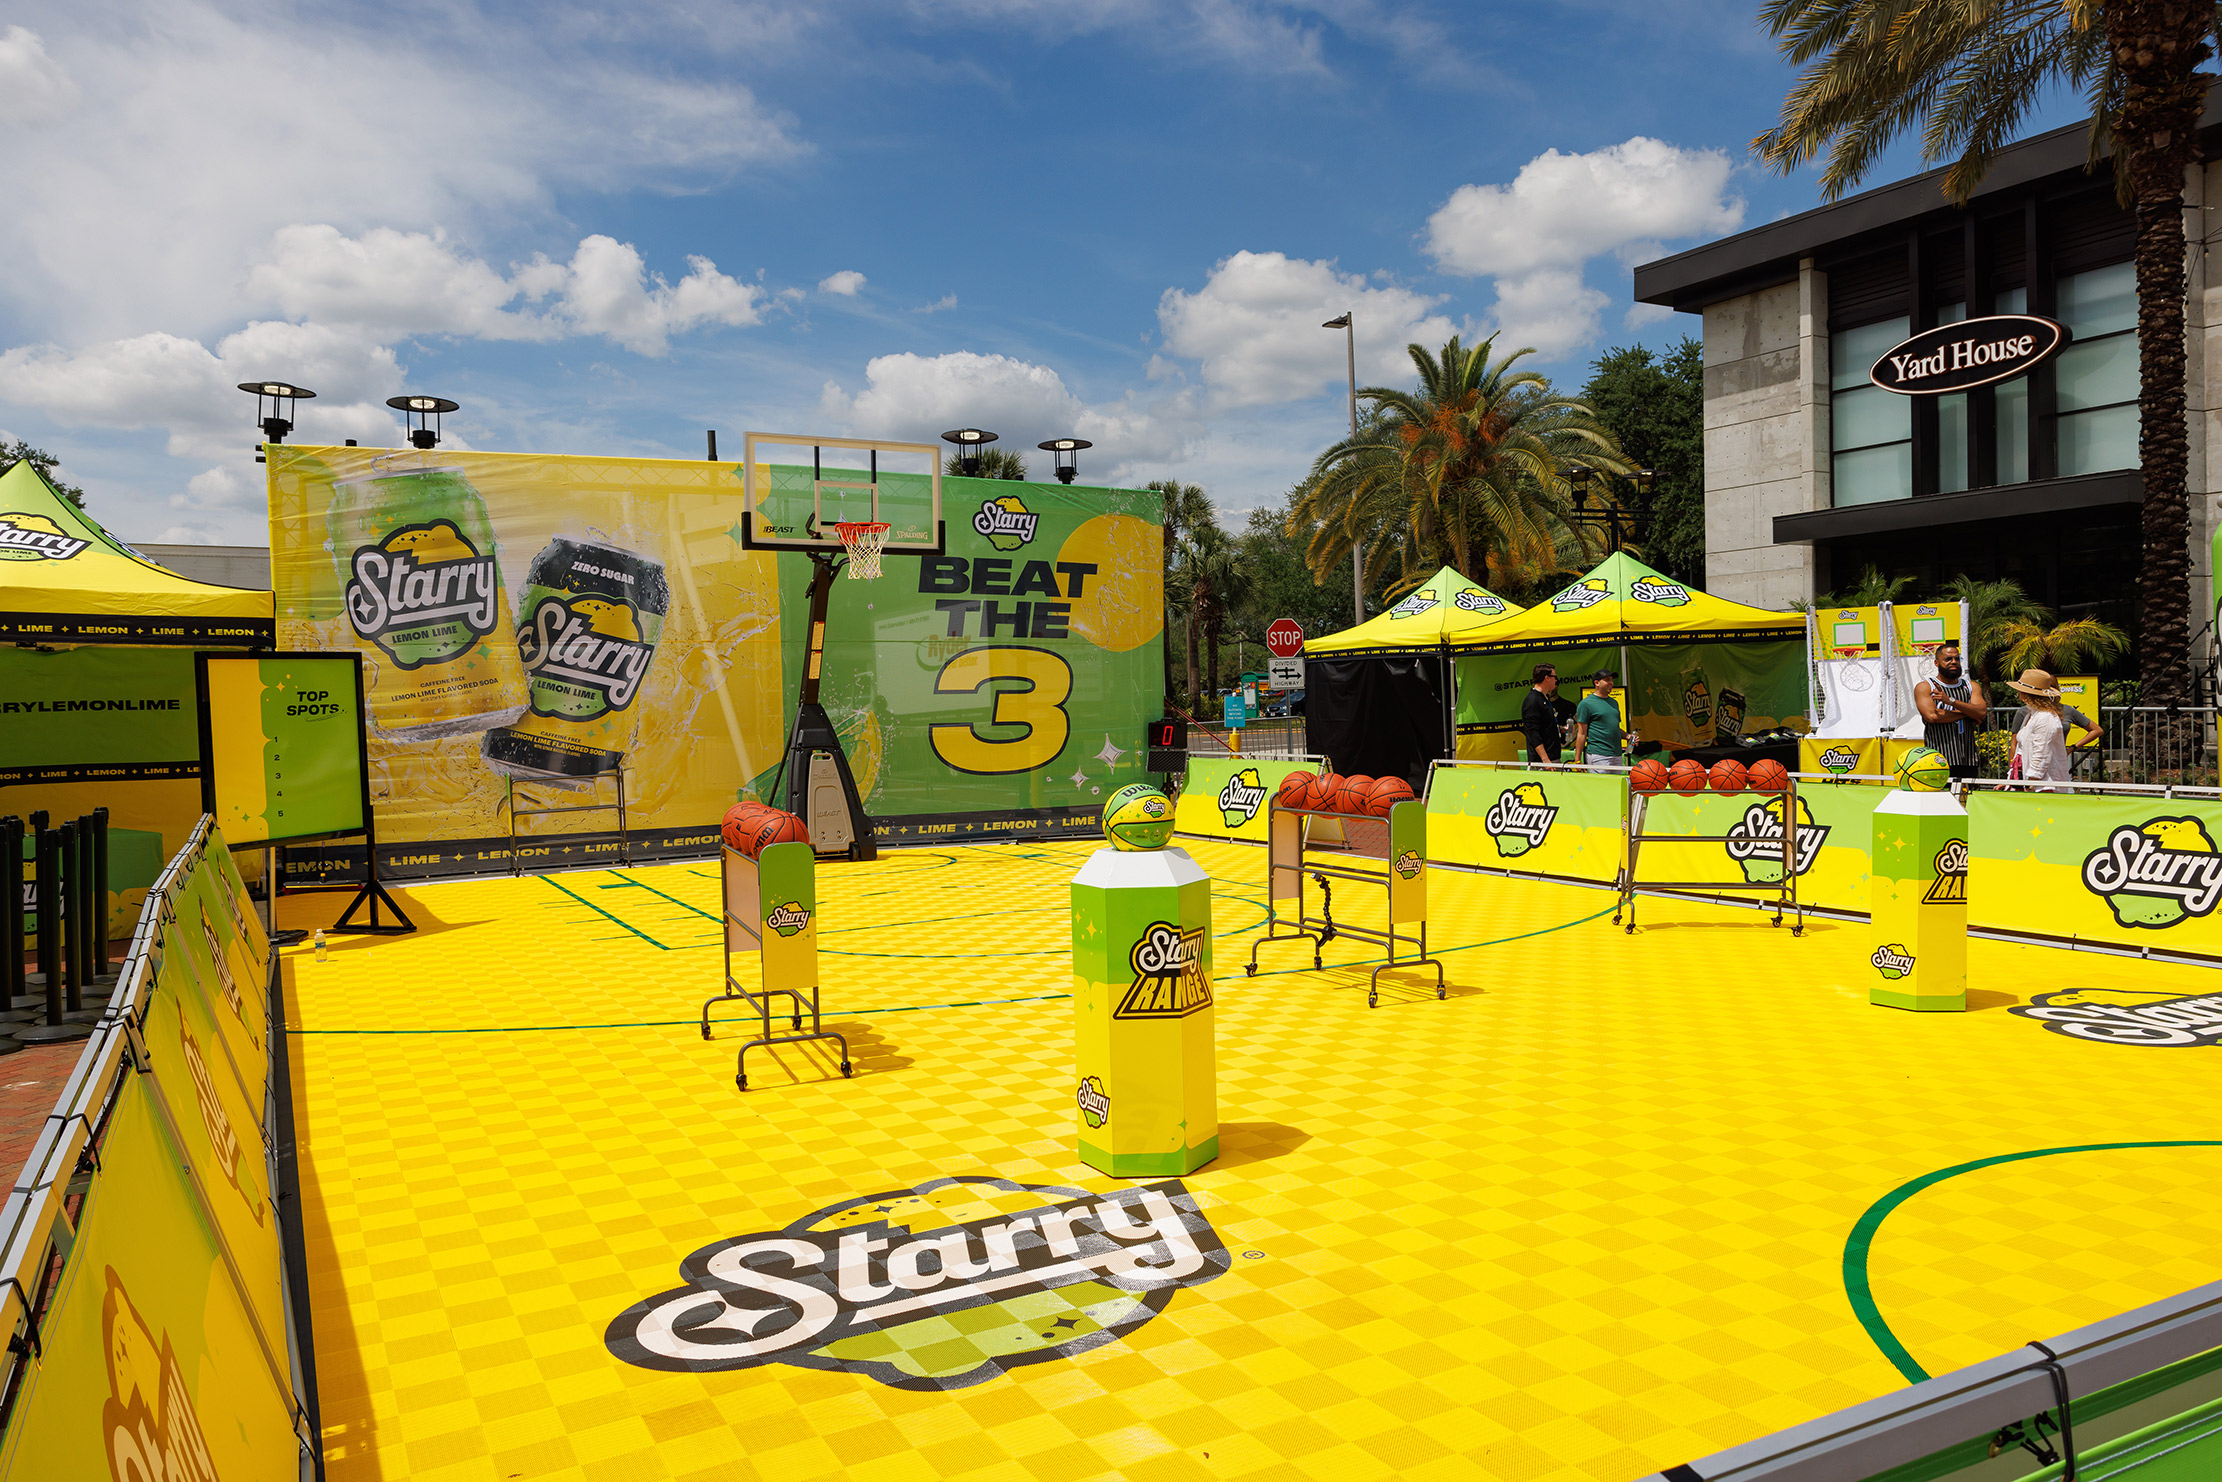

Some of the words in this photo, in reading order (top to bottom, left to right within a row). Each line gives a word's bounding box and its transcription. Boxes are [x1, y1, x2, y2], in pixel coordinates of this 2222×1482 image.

[1890, 346, 1946, 382] Yard
[1951, 334, 2036, 370] House
[764, 526, 795, 534] BEAST
[974, 502, 1038, 542] Starry
[896, 530, 928, 540] SPALDING
[570, 561, 600, 576] ZERO
[600, 567, 635, 585] SUGAR
[918, 556, 1098, 598] BEAT
[348, 551, 494, 634] Starry
[1456, 592, 1505, 610] Starry
[1552, 584, 1612, 608] Starry
[1632, 583, 1690, 602] Starry
[935, 600, 1071, 638] THE
[78, 626, 128, 634] LEMON
[152, 627, 184, 635] LIME
[208, 628, 254, 636] LEMON
[392, 630, 430, 644] LEMON
[432, 625, 458, 638] LIME
[1270, 631, 1301, 646] STOP
[517, 603, 652, 706] Starry
[391, 693, 416, 702] LEMON
[417, 689, 436, 698] LIME
[437, 681, 479, 694] FLAVORED
[479, 678, 499, 686] SODA
[420, 678, 450, 688] CAFFEINE
[538, 680, 571, 696] LEMON
[572, 688, 596, 700] LIME
[297, 691, 329, 702] TOP
[286, 704, 340, 716] SPOTS
[929, 645, 1074, 776] 3
[510, 731, 533, 742] LEMON
[534, 737, 551, 746] LIME
[552, 741, 589, 754] FLAVORED
[590, 748, 607, 756] SODA
[540, 731, 567, 741] CAFFEINE
[1162, 726, 1173, 745] 0
[1820, 750, 1859, 770] Starry
[1222, 778, 1264, 818] Starry
[918, 824, 956, 834] LIME
[983, 820, 1037, 830] LEMON
[1062, 816, 1096, 827] LIME
[1486, 793, 1555, 846] Starry
[390, 854, 441, 866] LIME
[1396, 852, 1423, 873] Starry
[768, 907, 810, 929] Starry
[1138, 930, 1200, 973] Starry
[1873, 948, 1915, 976] Starry
[1130, 974, 1206, 1010] RANGE
[1078, 1079, 1109, 1122] Starry
[636, 1189, 1206, 1361] Starry
